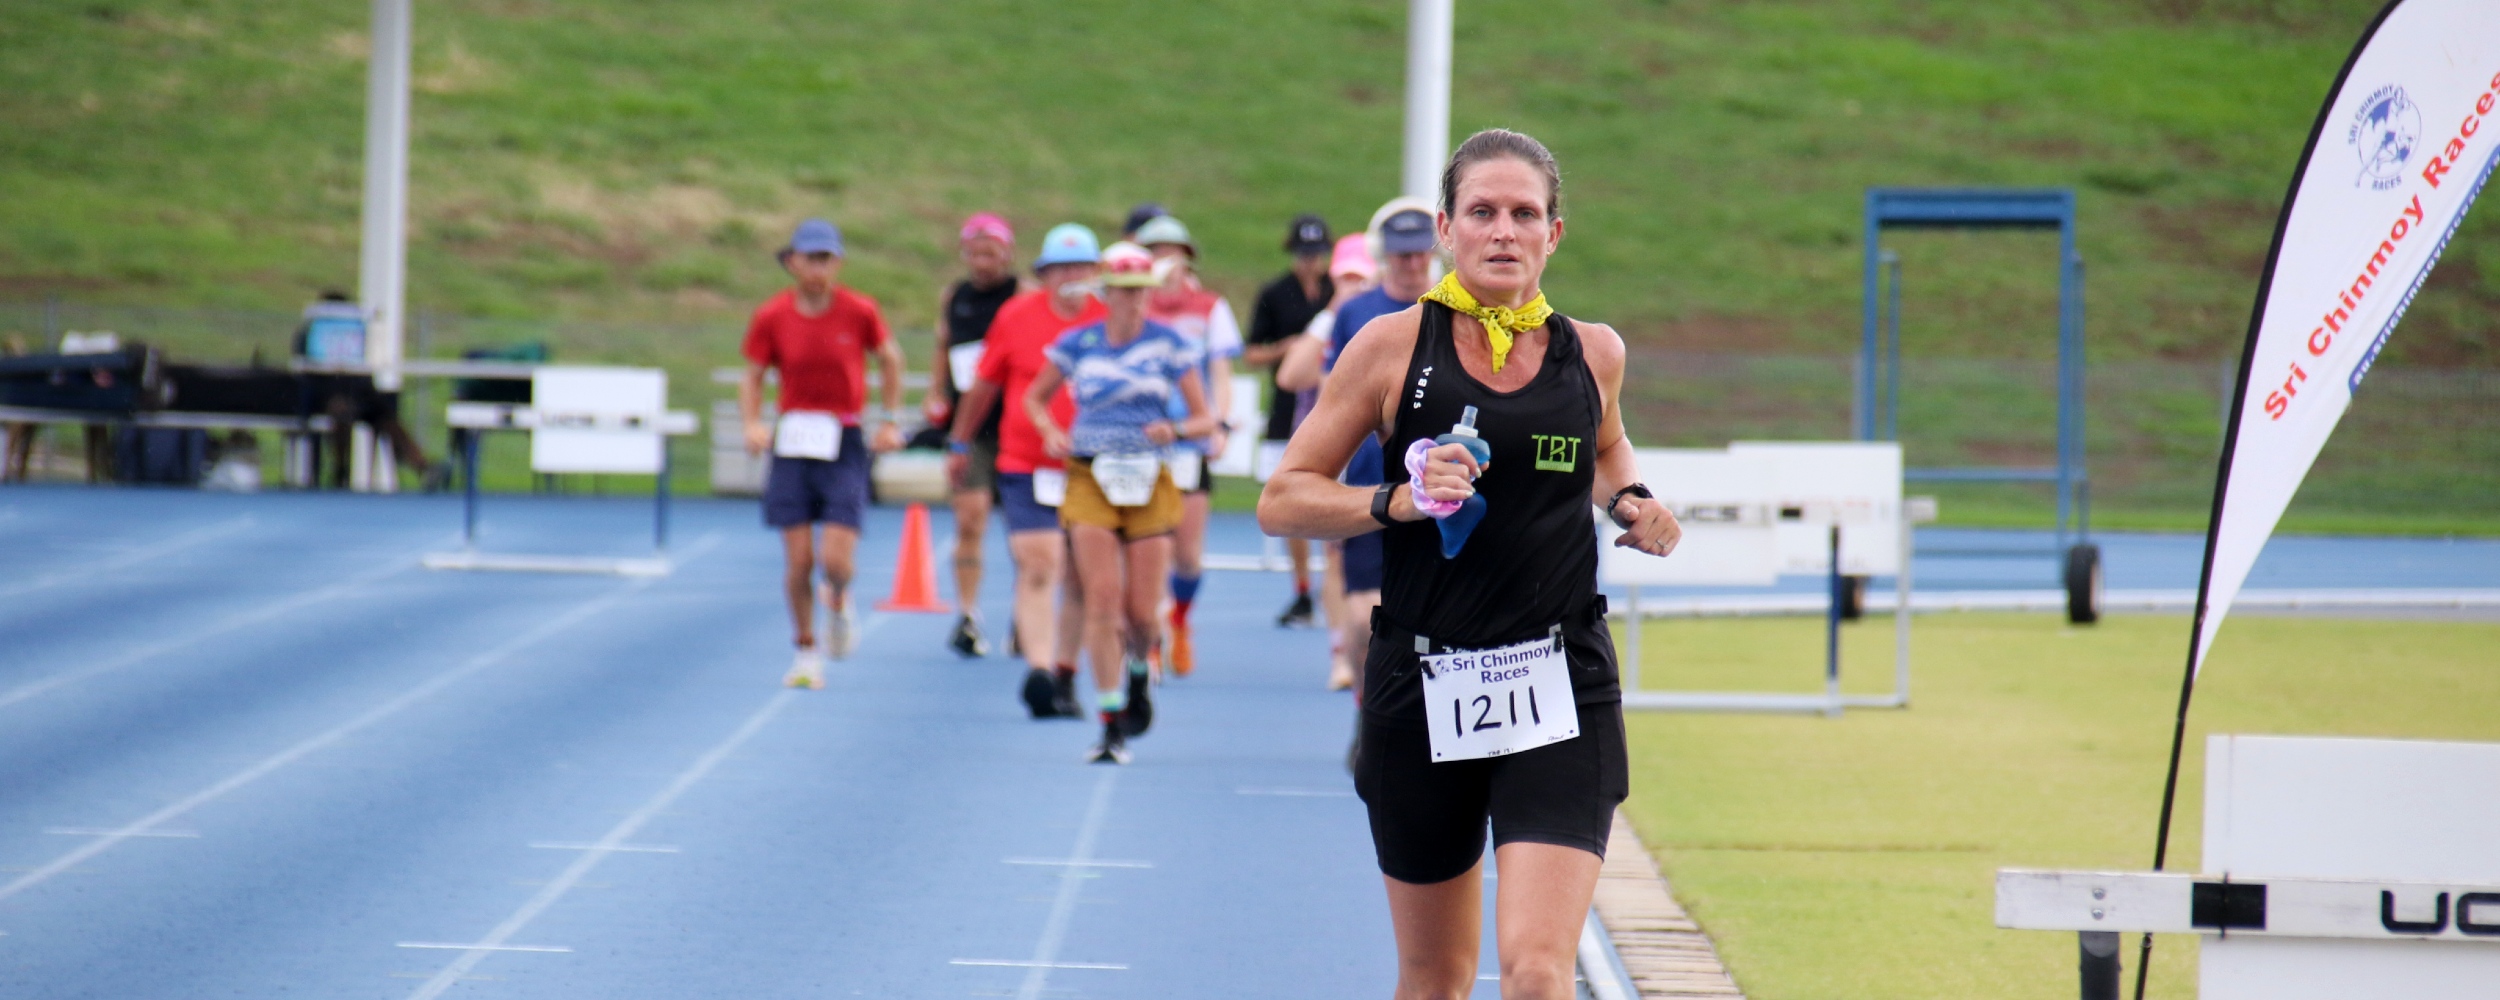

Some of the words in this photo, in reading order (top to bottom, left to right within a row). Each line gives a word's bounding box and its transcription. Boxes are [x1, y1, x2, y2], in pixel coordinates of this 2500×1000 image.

[2264, 362, 2307, 421] Sri
[2307, 194, 2424, 357] Chinmoy
[1452, 656, 1475, 671] Sri
[1480, 644, 1552, 669] Chinmoy
[1480, 666, 1530, 684] Races
[1454, 685, 1541, 739] 1211
